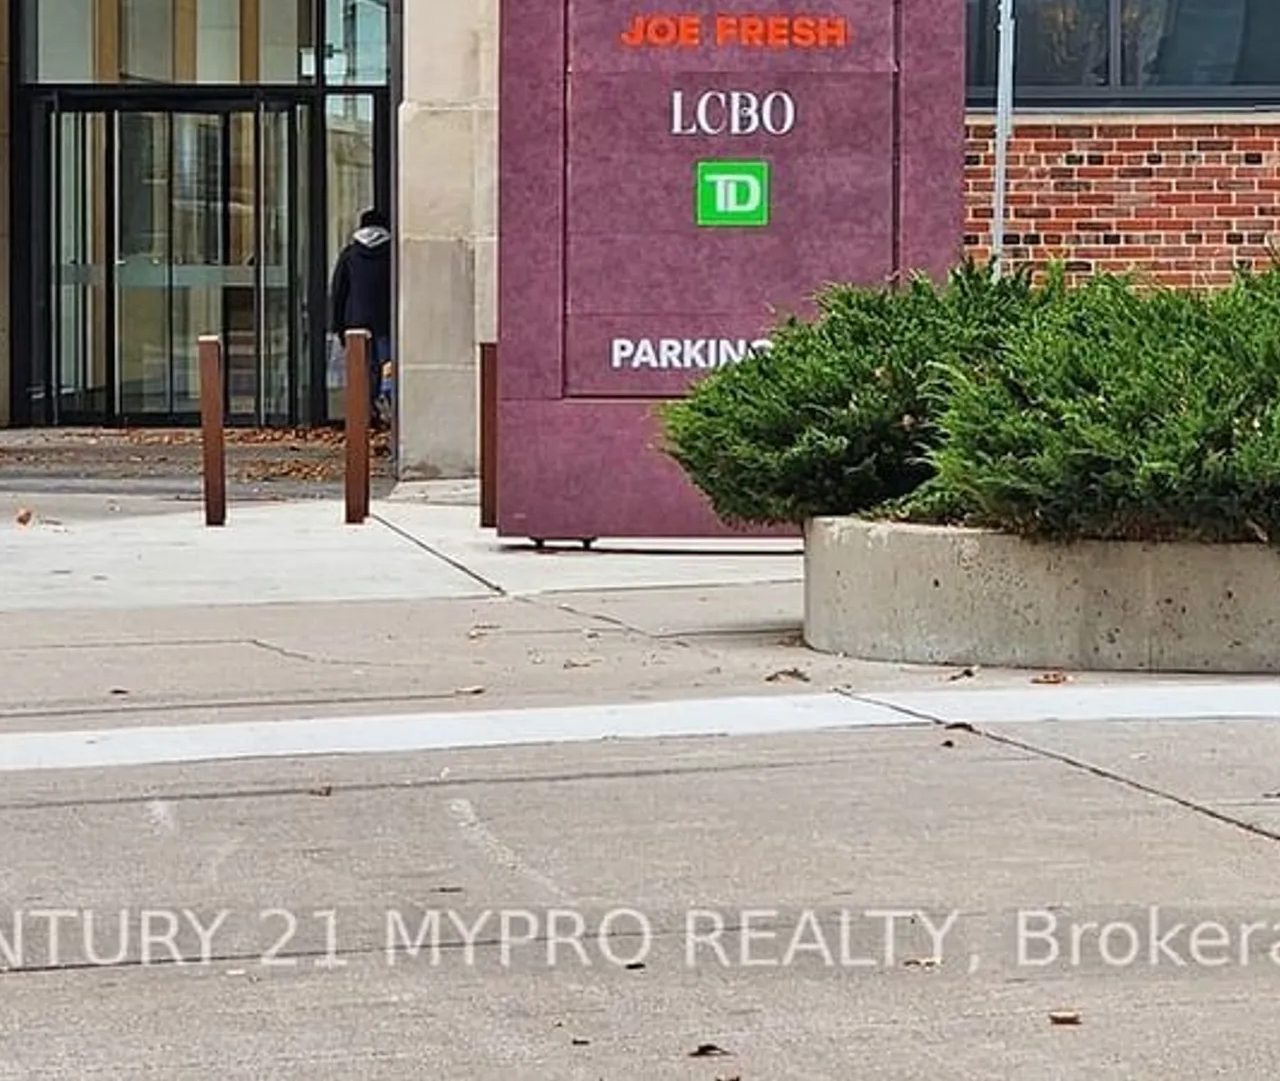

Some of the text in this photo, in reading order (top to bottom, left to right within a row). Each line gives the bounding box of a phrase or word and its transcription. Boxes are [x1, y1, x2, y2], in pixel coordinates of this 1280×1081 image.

[621, 16, 848, 47] JOE FRESH
[671, 90, 795, 134] LCBO
[705, 174, 761, 213] TD
